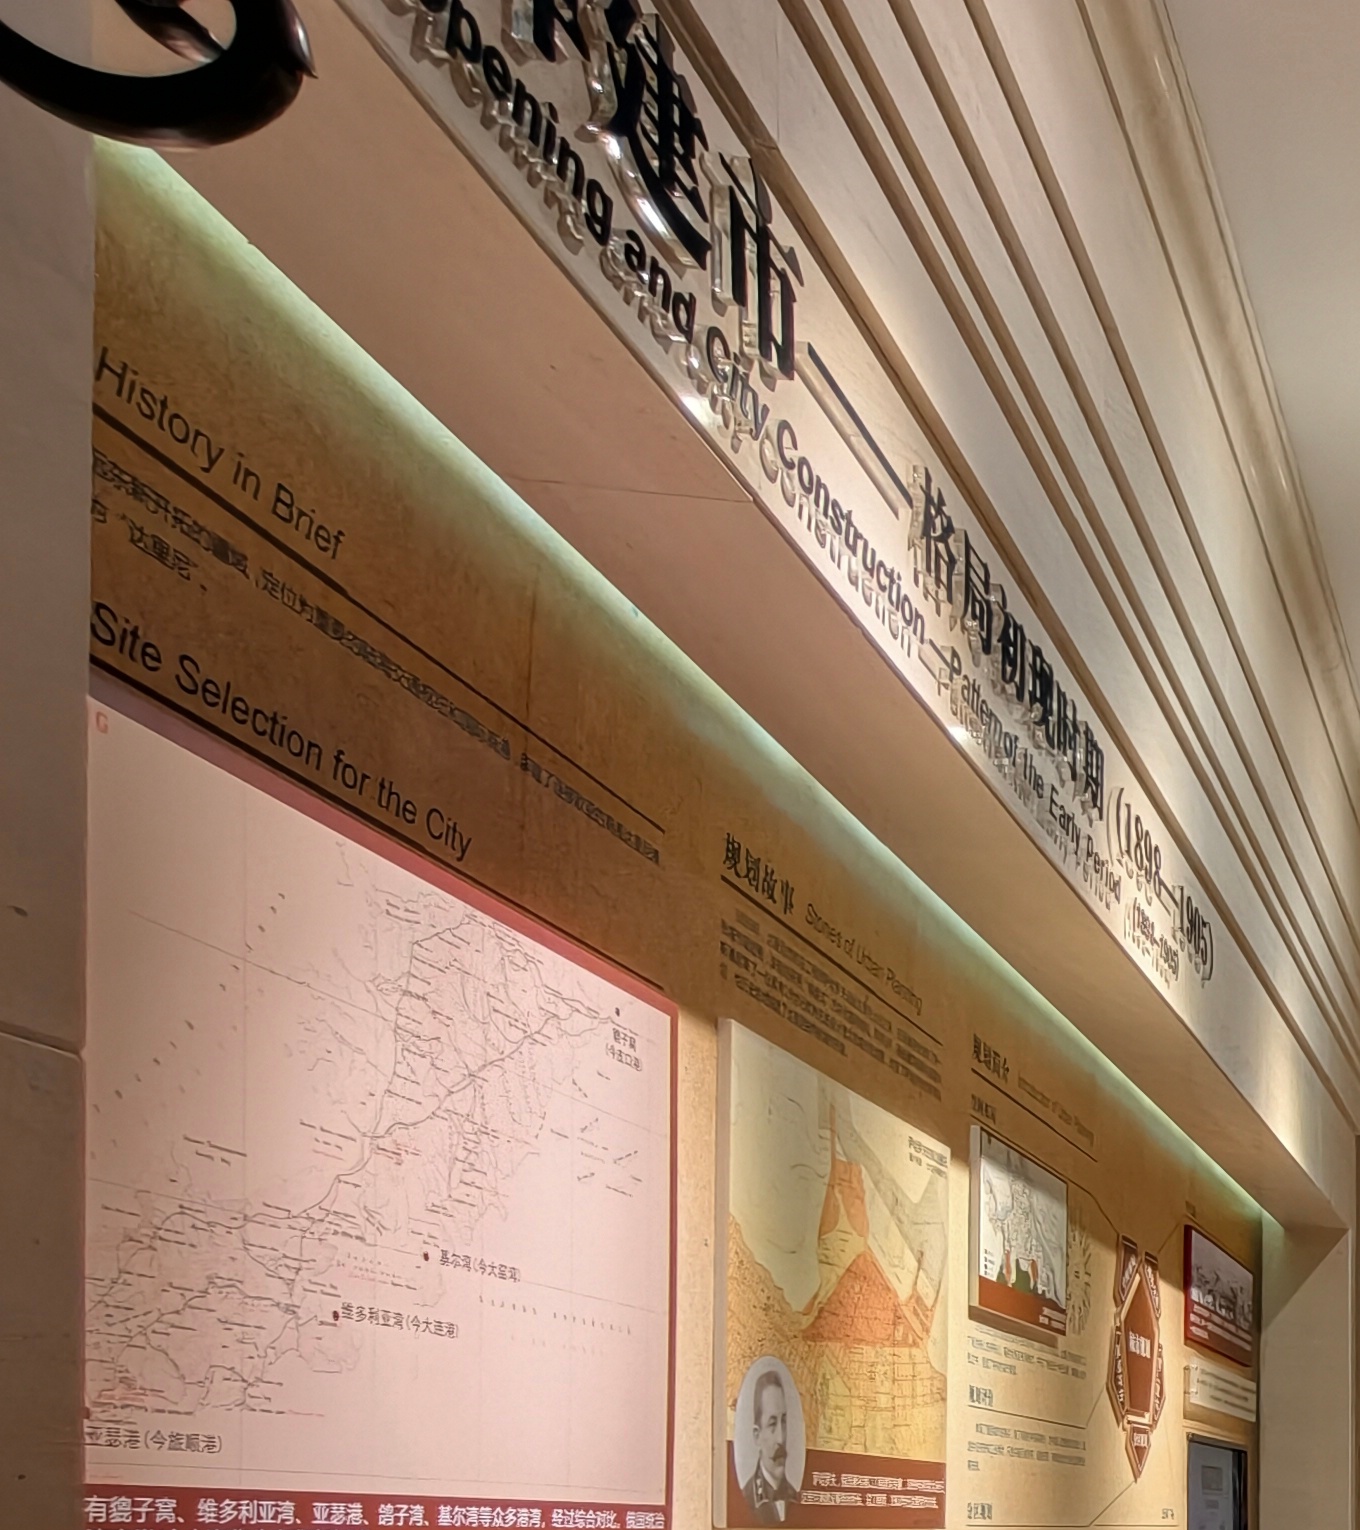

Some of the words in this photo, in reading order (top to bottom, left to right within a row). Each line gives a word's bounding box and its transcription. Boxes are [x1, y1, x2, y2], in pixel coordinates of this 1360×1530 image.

[95, 344, 225, 472] History
[231, 450, 261, 503] in
[273, 481, 347, 562] Brief
[624, 229, 697, 341] and
[703, 325, 772, 439] City
[776, 418, 927, 646] Construction
[91, 602, 164, 674] Site
[175, 652, 324, 773] Selection
[333, 746, 370, 797] for
[378, 775, 418, 827] the
[426, 806, 473, 866] City
[722, 832, 797, 917] 规划故事
